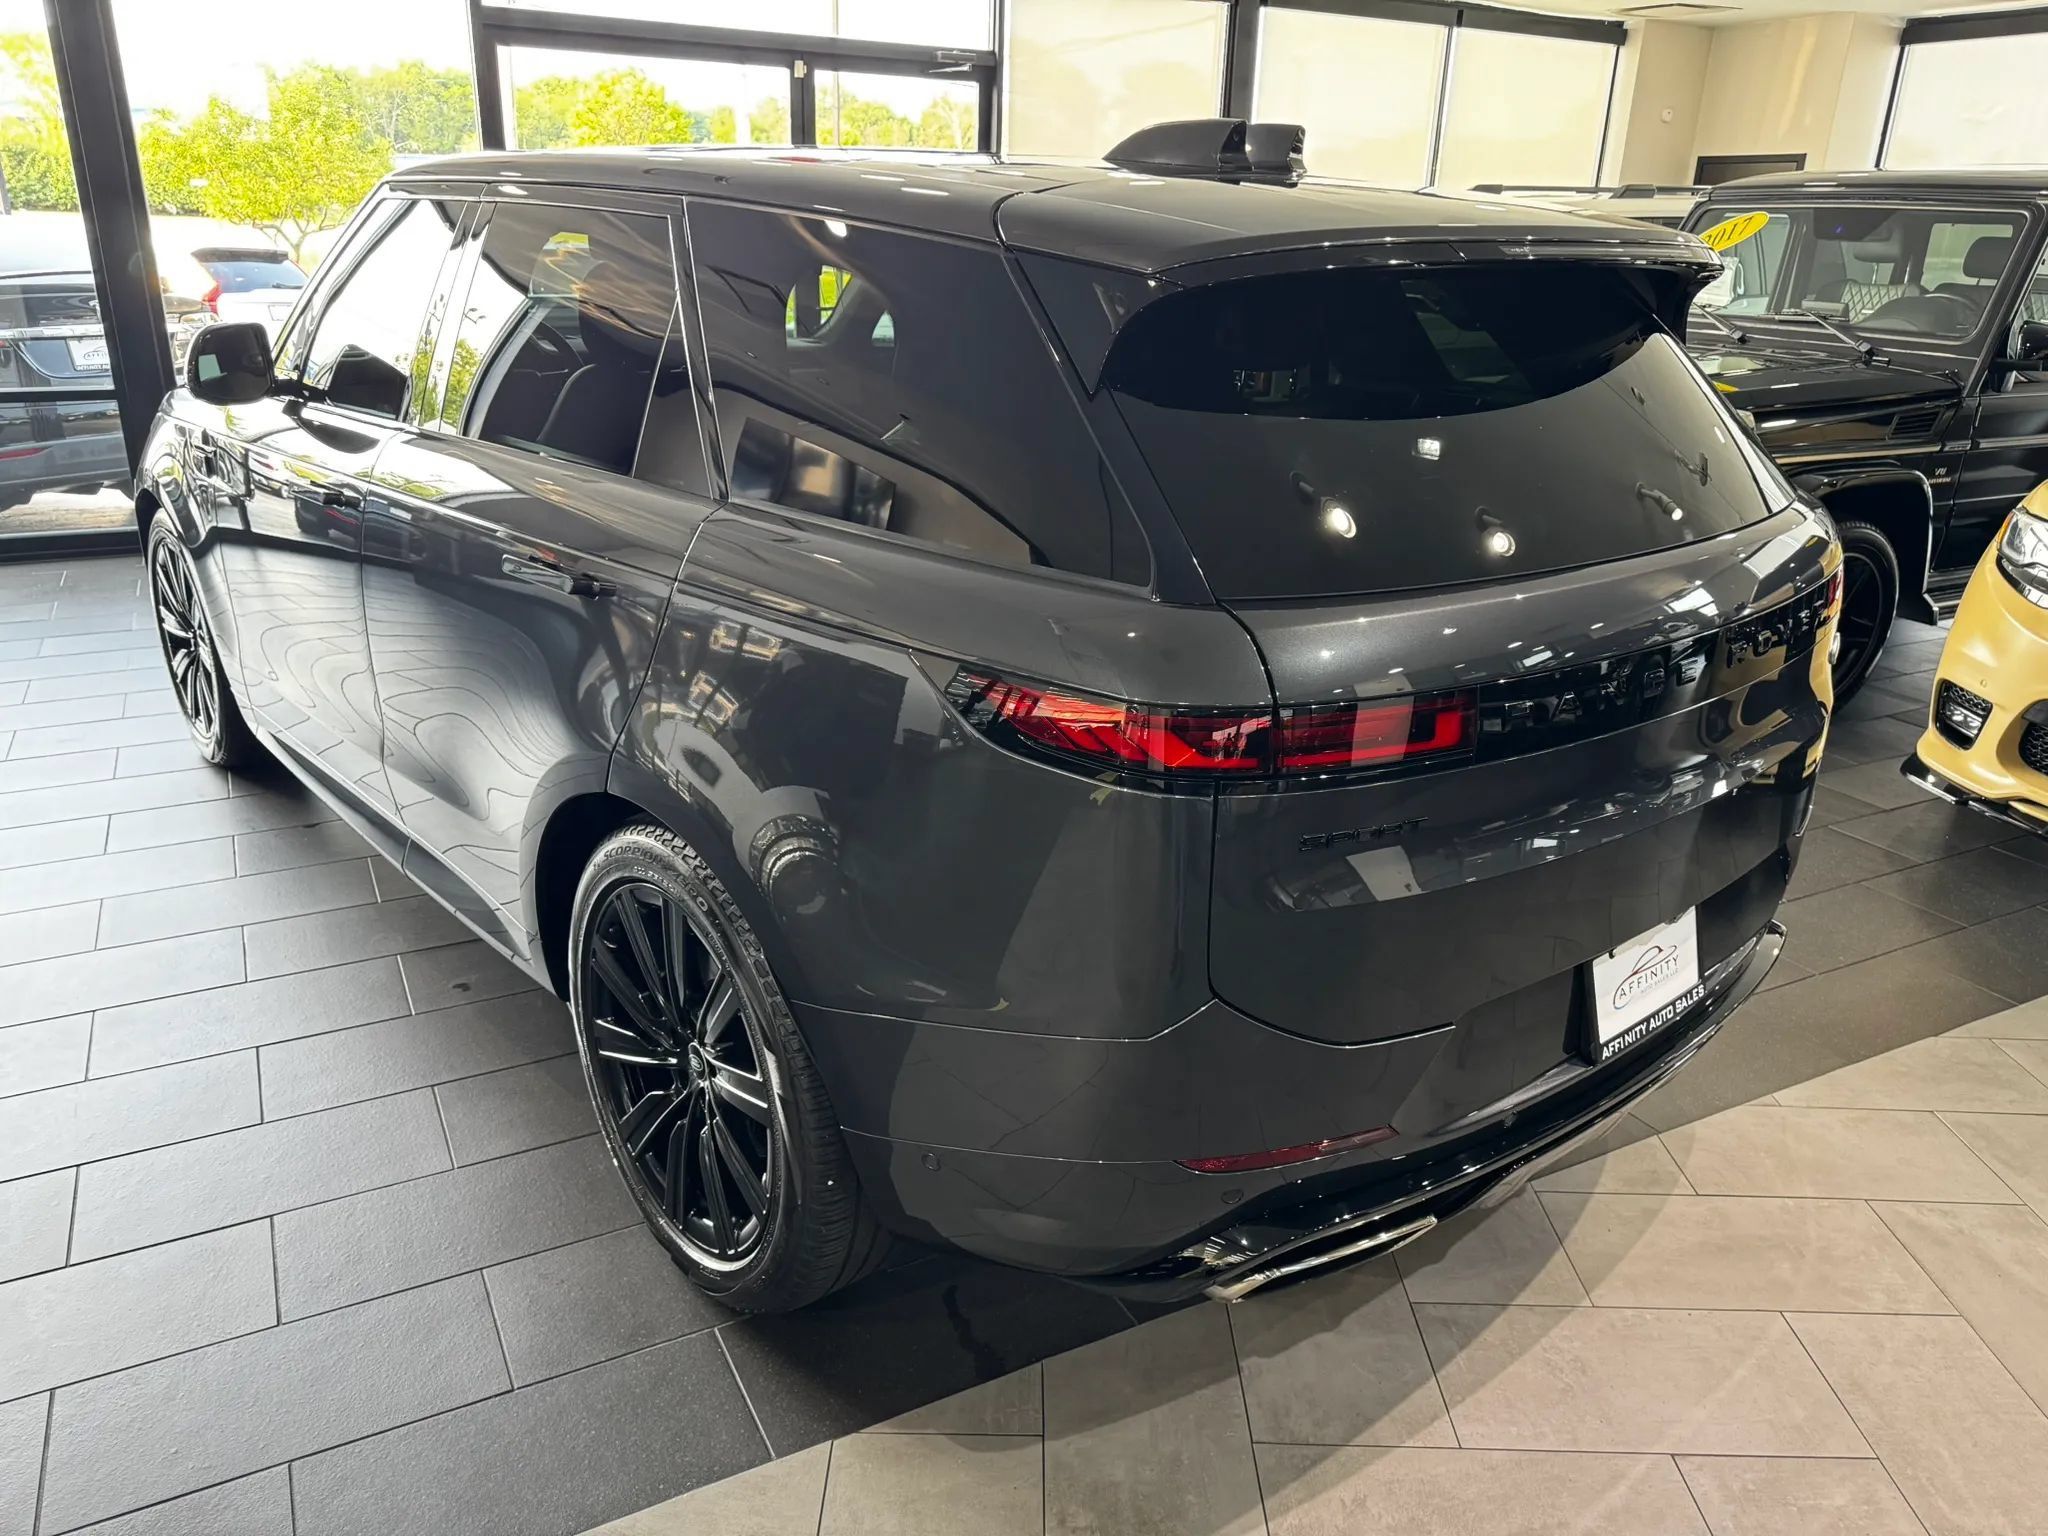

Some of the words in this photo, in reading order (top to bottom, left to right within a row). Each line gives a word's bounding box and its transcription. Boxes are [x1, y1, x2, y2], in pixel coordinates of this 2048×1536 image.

[1620, 955, 1679, 999] AFFINITY
[1602, 1022, 1648, 1060] AFFINITY
[1649, 1004, 1674, 1031] AUTO
[1675, 984, 1705, 1013] SALES
